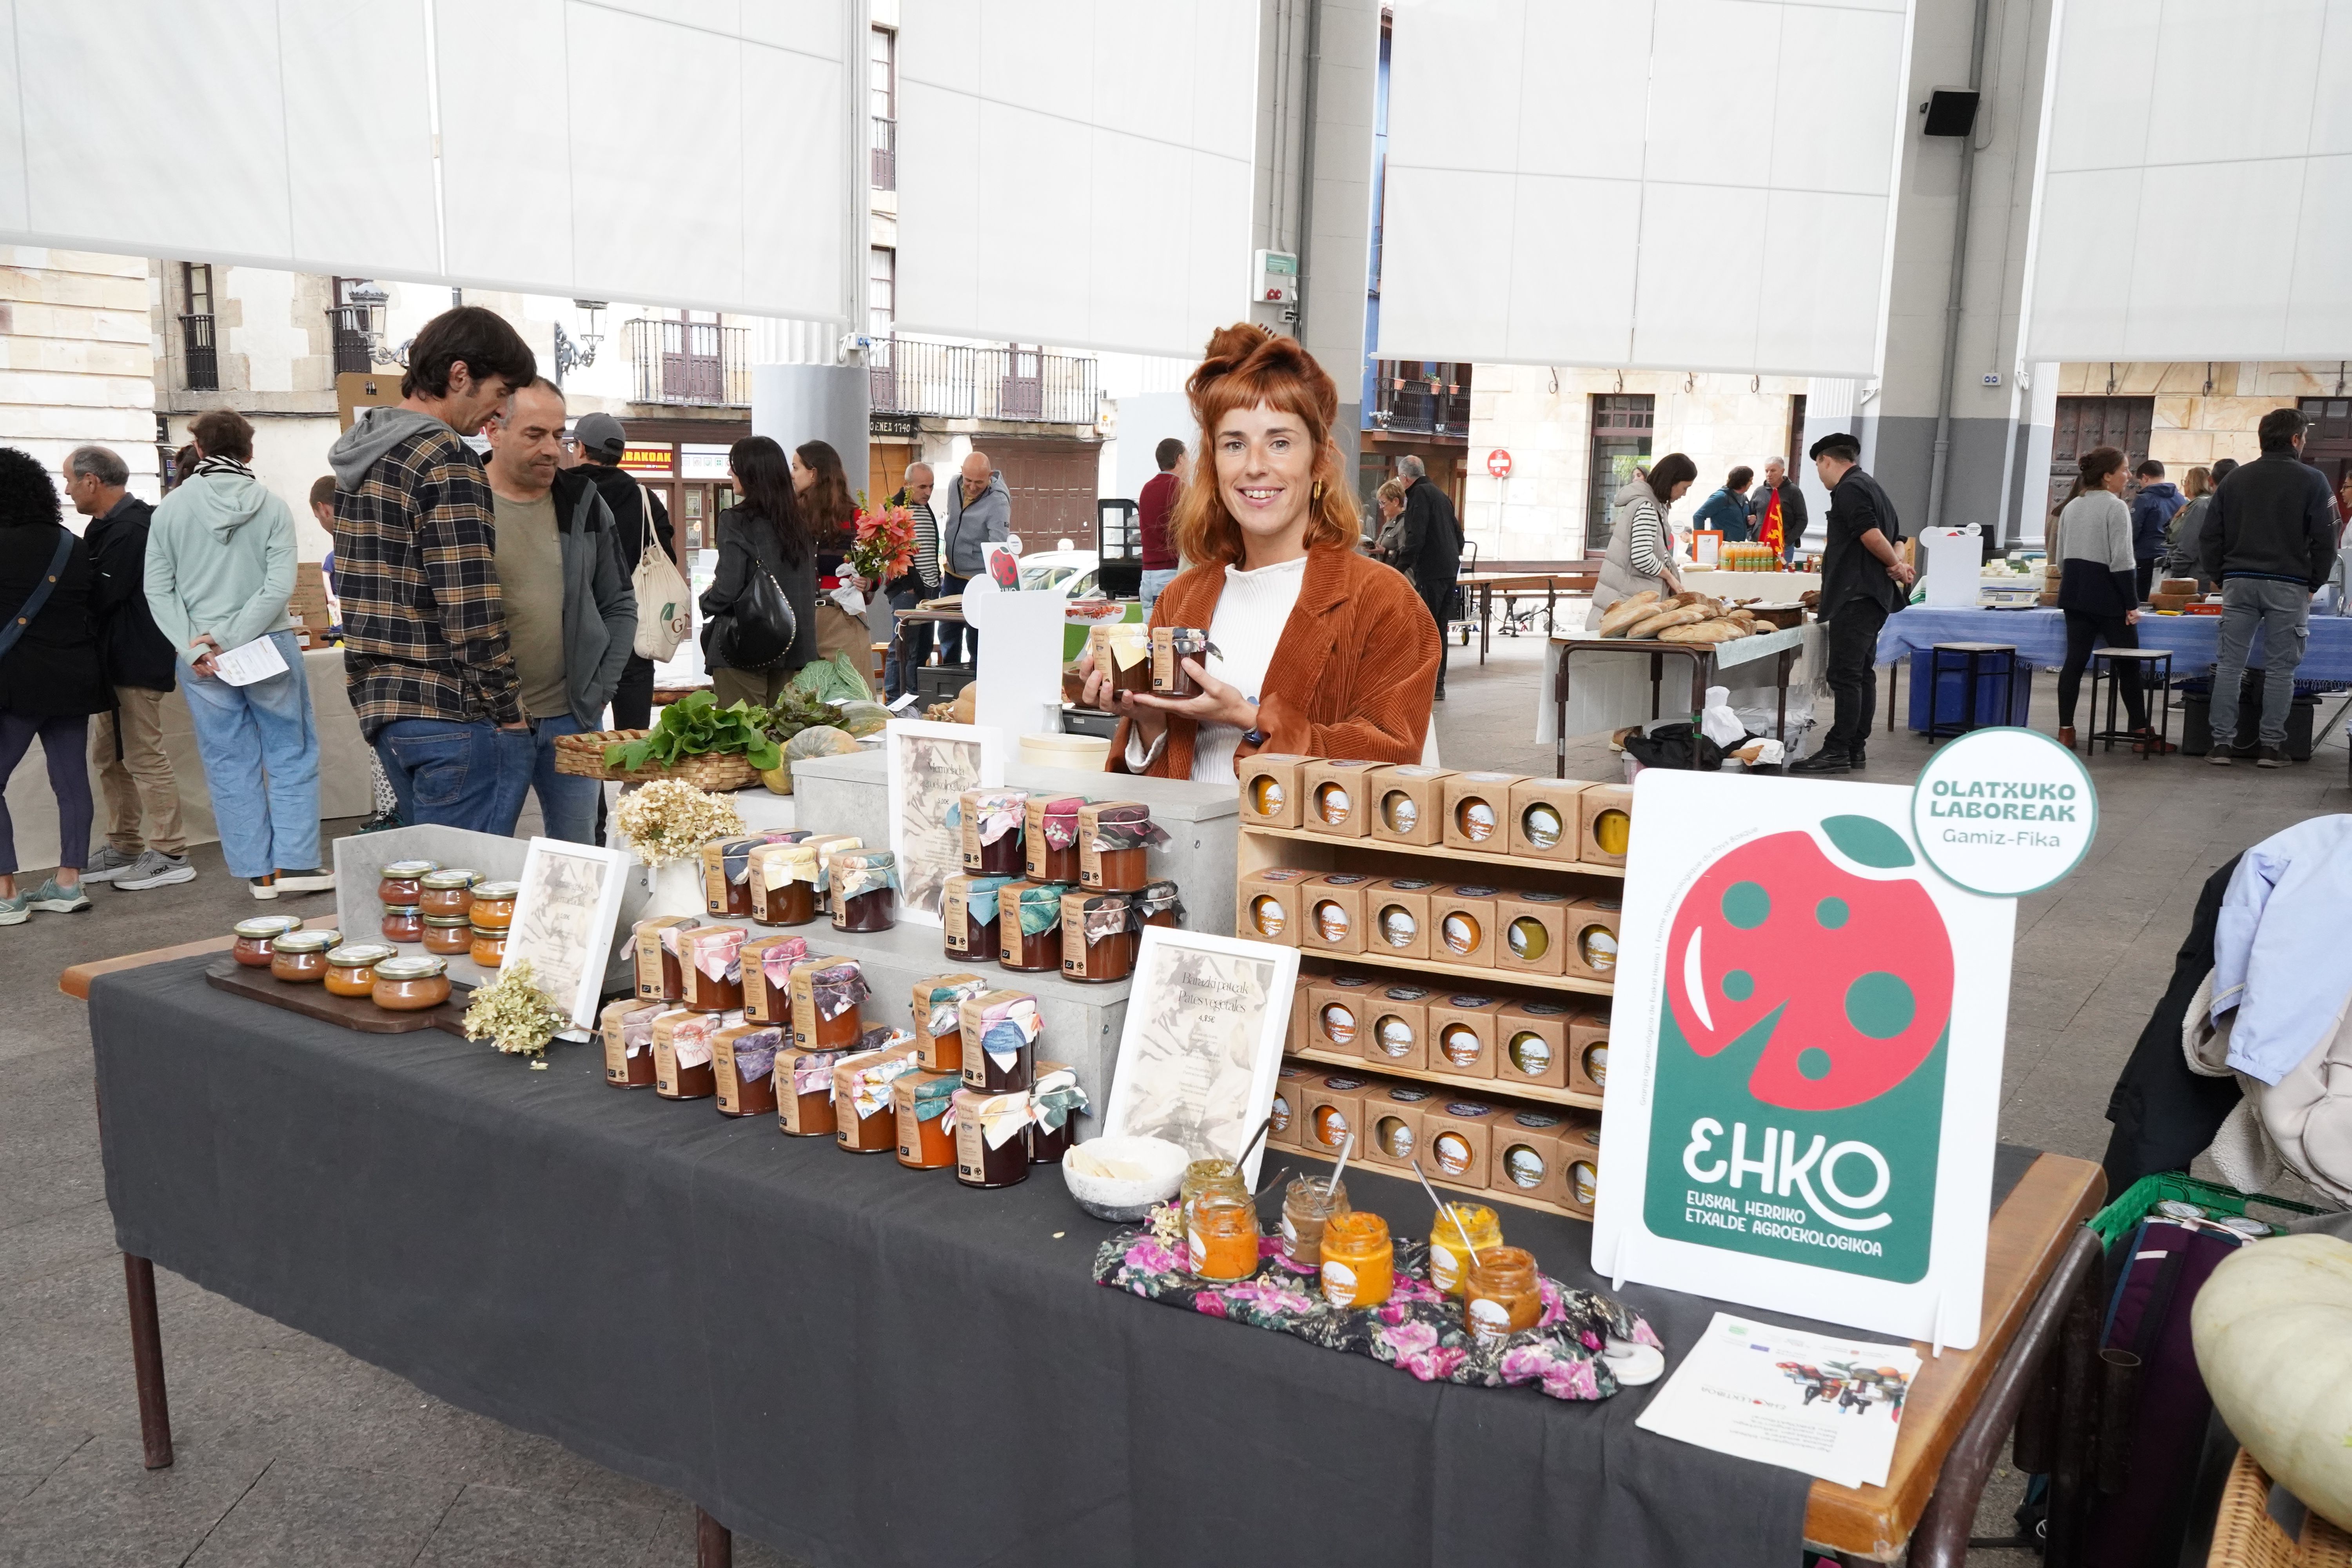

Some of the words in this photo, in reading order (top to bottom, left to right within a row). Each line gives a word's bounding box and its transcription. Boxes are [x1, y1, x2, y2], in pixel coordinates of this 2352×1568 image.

[875, 422, 892, 432] ENEA
[894, 423, 910, 433] 1740
[1932, 780, 2076, 800] OLATXUKO
[1930, 801, 2075, 822] LABOREAK
[1729, 826, 1759, 842] Basque
[1942, 828, 2060, 848] Gamiz-Fika
[150, 865, 169, 877] HOKA
[1182, 972, 1217, 989] Barazki
[1217, 981, 1249, 994] pateak
[1178, 990, 1203, 1006] Pates
[1204, 998, 1247, 1013] vegetales
[1198, 1014, 1216, 1023] 4,85€
[1683, 1117, 1893, 1231] EHKO
[1687, 1190, 1739, 1213] EUSKAL
[1745, 1200, 1806, 1225] HERRIKO
[1686, 1207, 1746, 1232] ETXALDE
[1752, 1220, 1882, 1257] AGROEKOLOGIKOA
